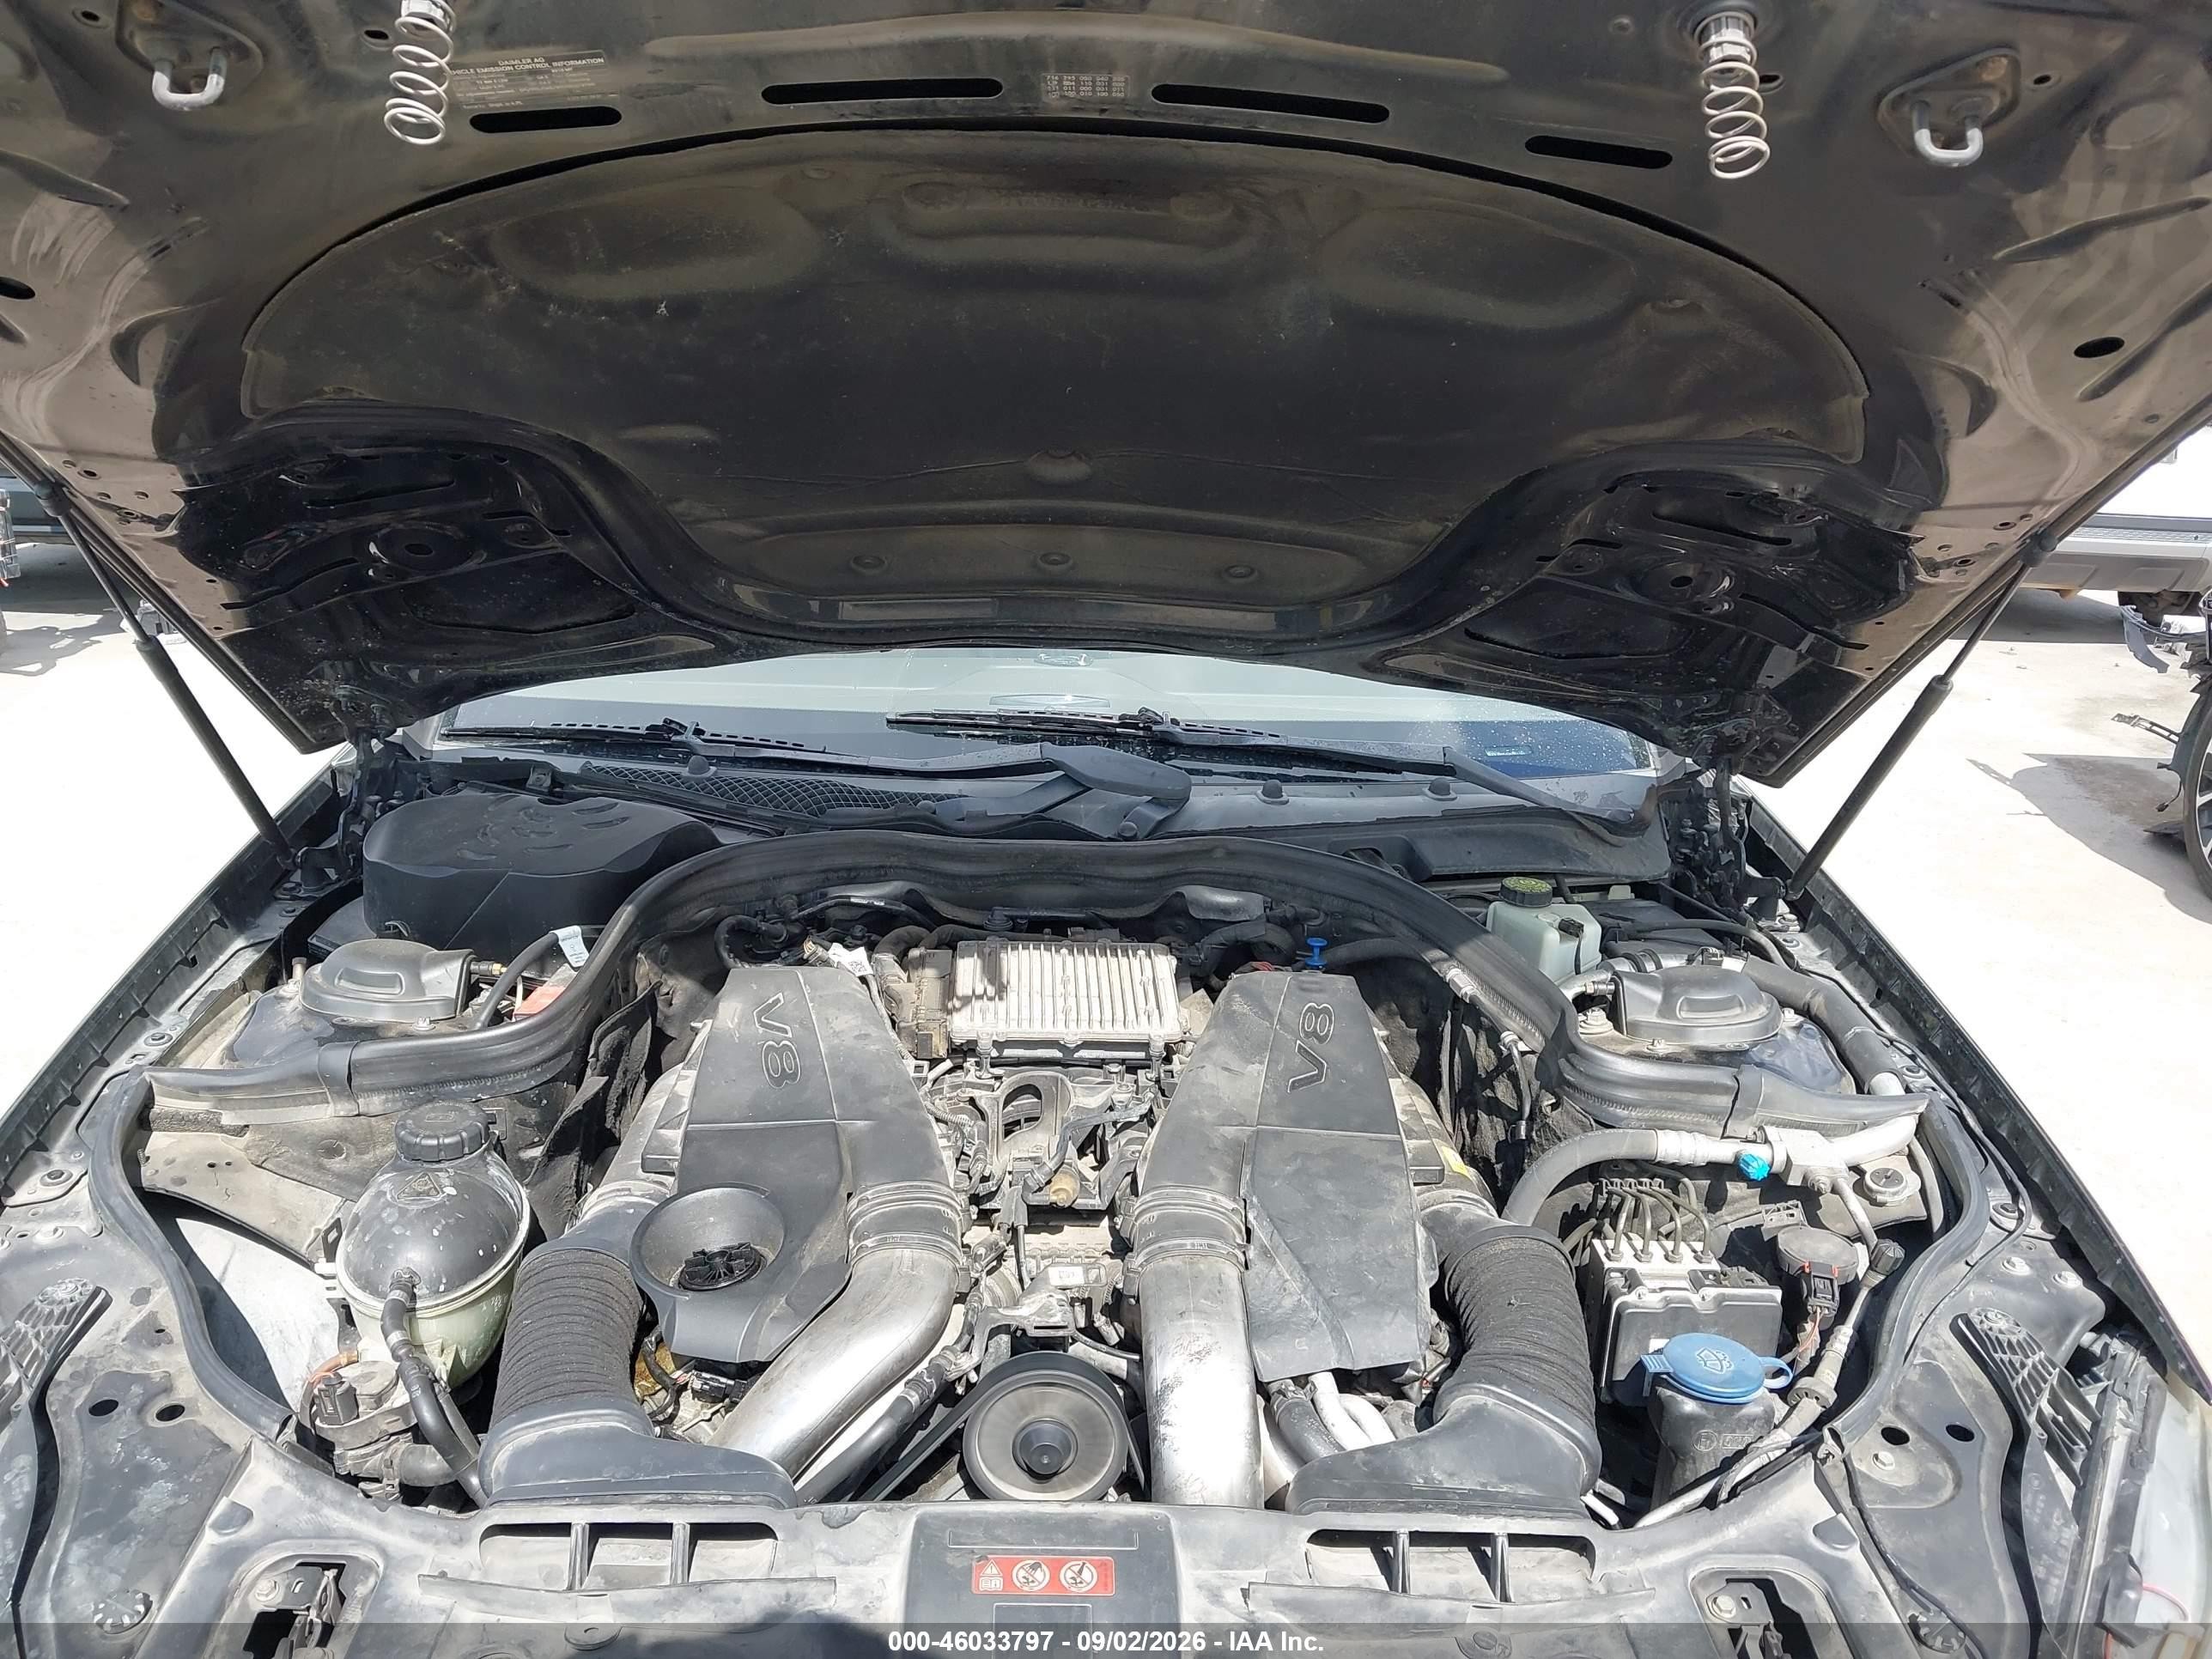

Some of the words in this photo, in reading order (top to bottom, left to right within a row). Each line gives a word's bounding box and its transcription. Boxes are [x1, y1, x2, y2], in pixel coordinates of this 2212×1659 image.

[476, 65, 514, 74] EMISSION
[515, 63, 550, 71] CONTROL
[551, 58, 605, 68] INFORMATION
[498, 58, 532, 66] DAIMLER
[754, 994, 802, 1089] V8
[1287, 1002, 1334, 1092] V8
